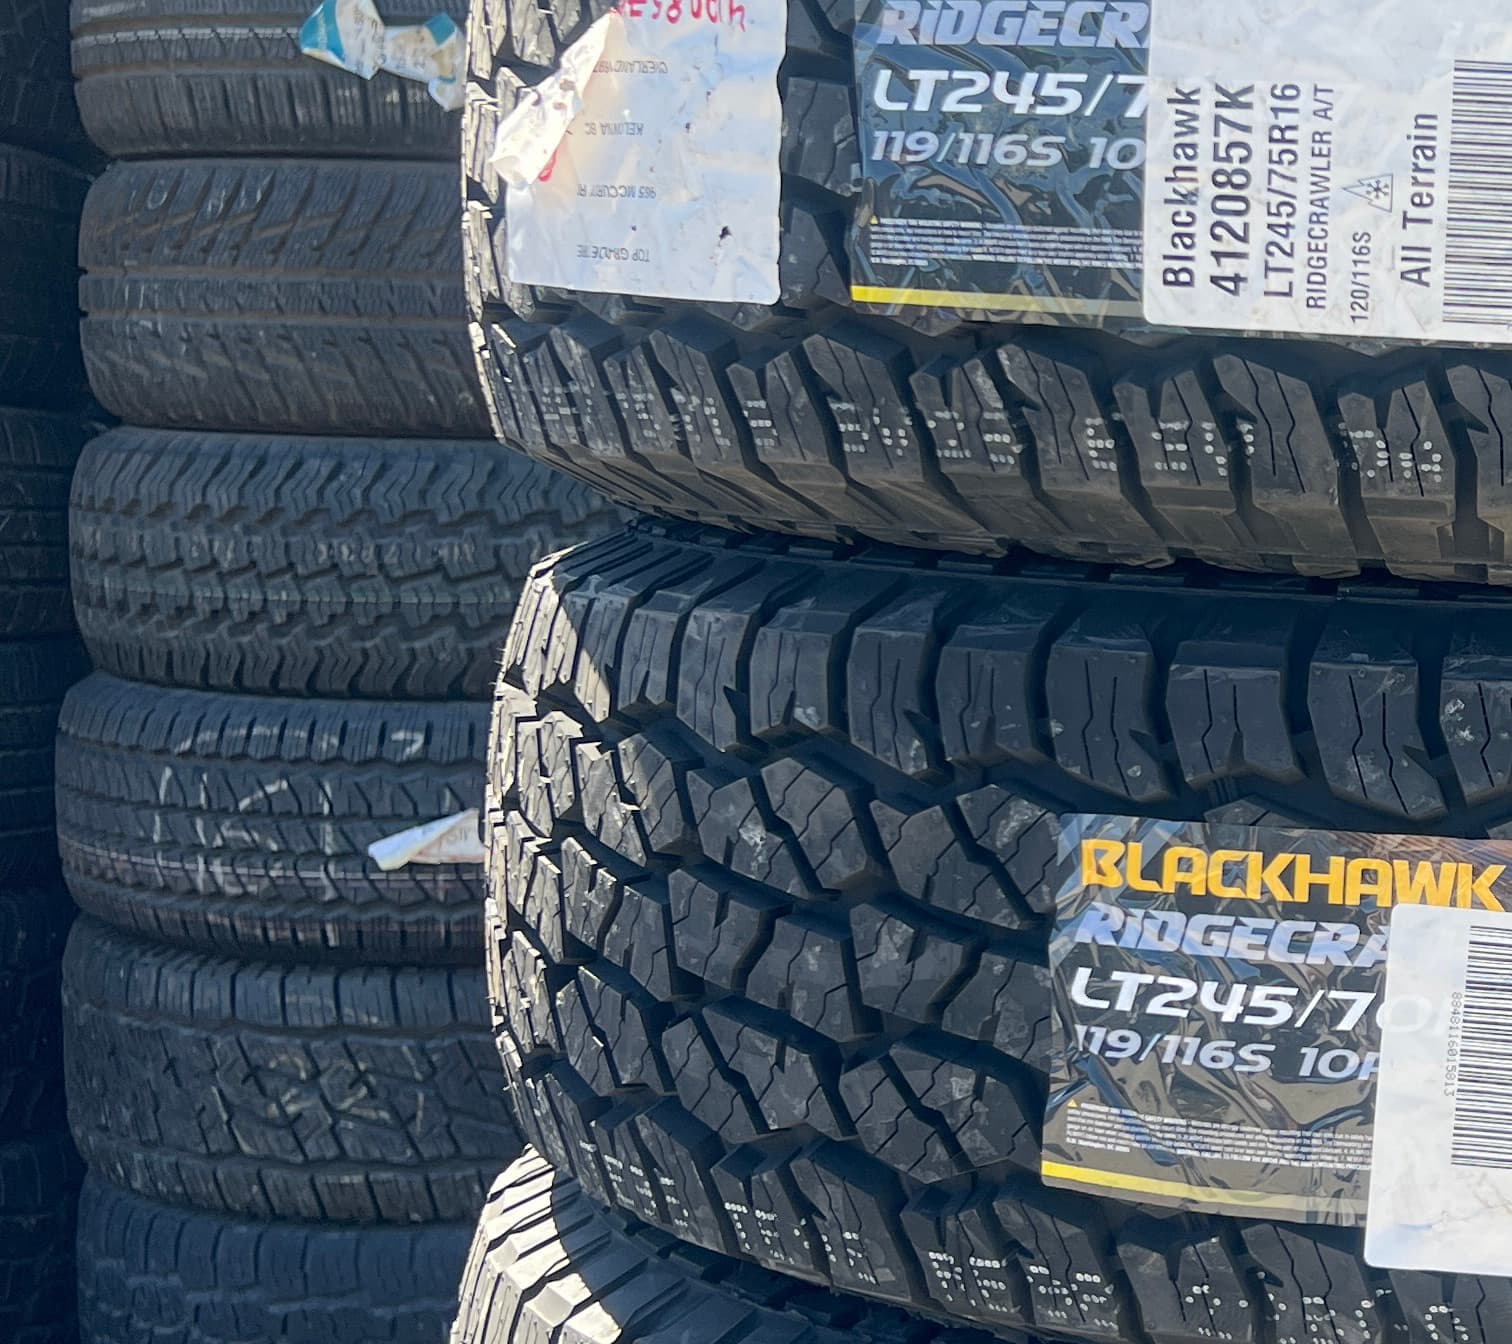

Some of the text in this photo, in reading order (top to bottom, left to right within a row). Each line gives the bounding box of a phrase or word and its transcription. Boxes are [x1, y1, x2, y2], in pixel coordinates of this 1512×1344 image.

[876, 0, 1150, 48] RIDGECR
[870, 130, 1067, 168] 119/116S
[1162, 85, 1202, 289] Blackhawk
[1210, 82, 1256, 296] 4120857K
[1264, 82, 1301, 299] LT245/75R16
[1306, 83, 1335, 311] RIDGECRAWLER A/T
[1401, 112, 1438, 288] All Terrain
[1349, 231, 1371, 323] 120/116S
[1081, 838, 1507, 913] BLACKHAWK
[1071, 966, 1387, 1033] LT245/7
[1444, 991, 1464, 1098] 8848116015813
[1075, 1024, 1276, 1075] 119/116S
